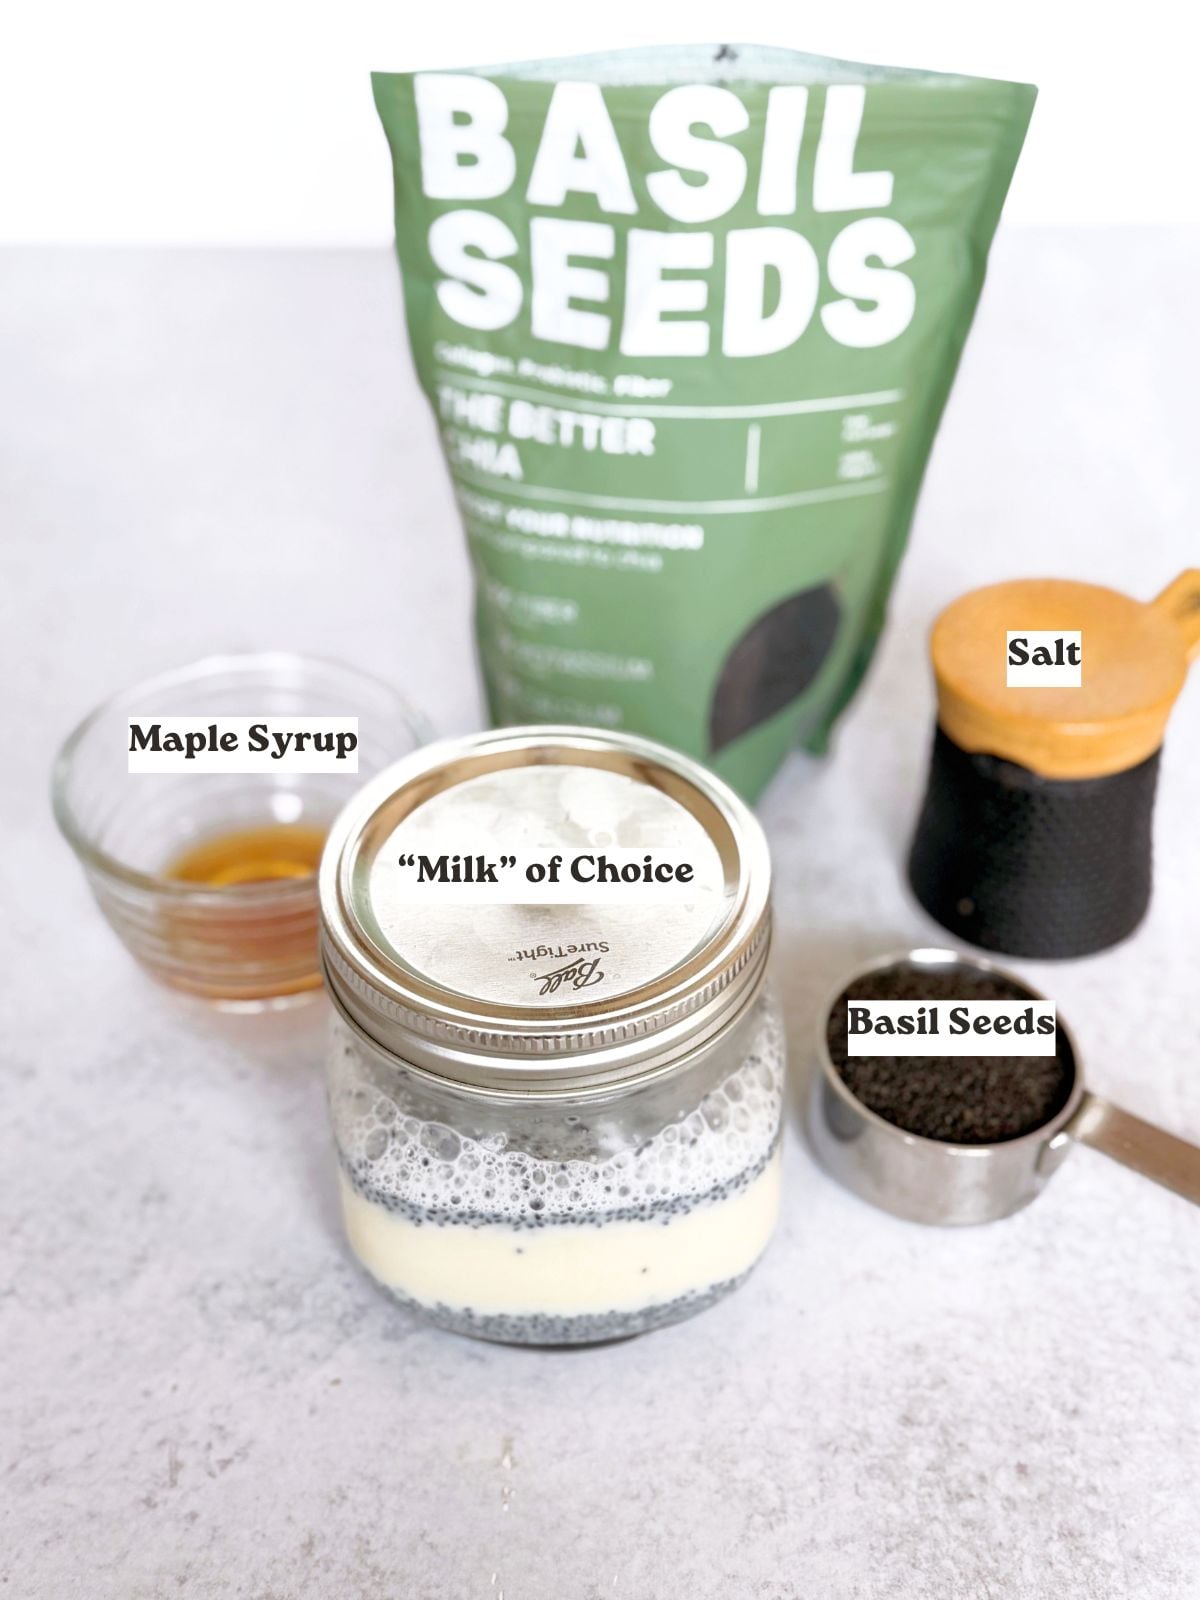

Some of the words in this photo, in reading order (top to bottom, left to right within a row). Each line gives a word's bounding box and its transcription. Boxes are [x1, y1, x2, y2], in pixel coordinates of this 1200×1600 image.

[414, 72, 895, 223] BASIL
[427, 209, 917, 358] SEEDS
[437, 386, 501, 434] THE
[508, 400, 656, 457] BETTER
[505, 508, 569, 538] YOUR
[570, 515, 704, 550] NUTRITION
[534, 957, 604, 996] Ball
